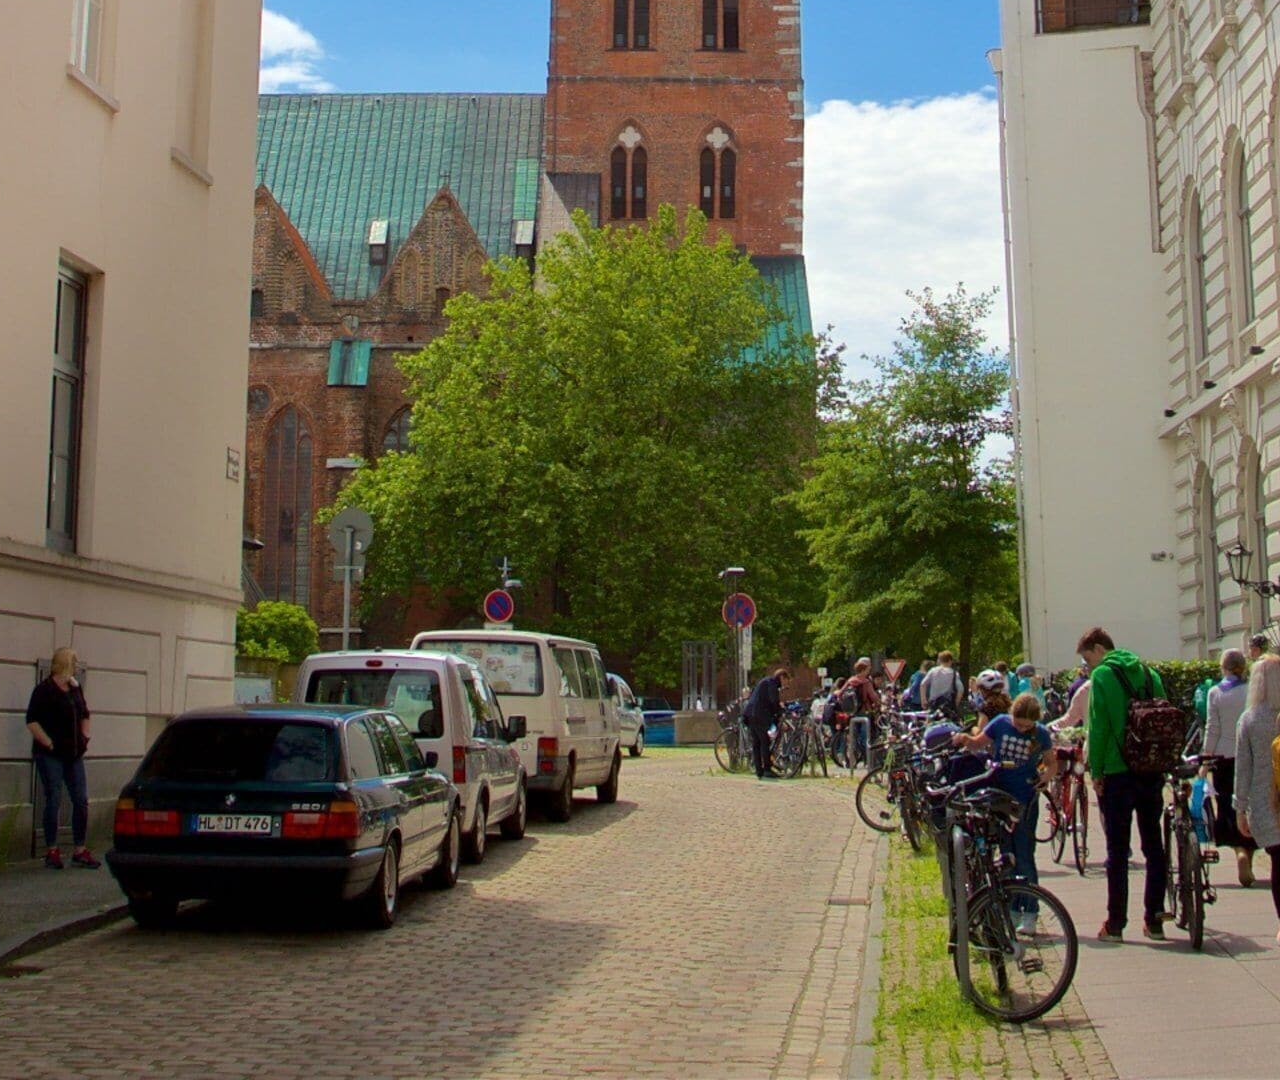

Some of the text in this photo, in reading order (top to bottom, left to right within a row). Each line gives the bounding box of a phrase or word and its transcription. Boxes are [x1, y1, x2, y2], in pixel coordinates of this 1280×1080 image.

[199, 816, 270, 831] HL DT 476
